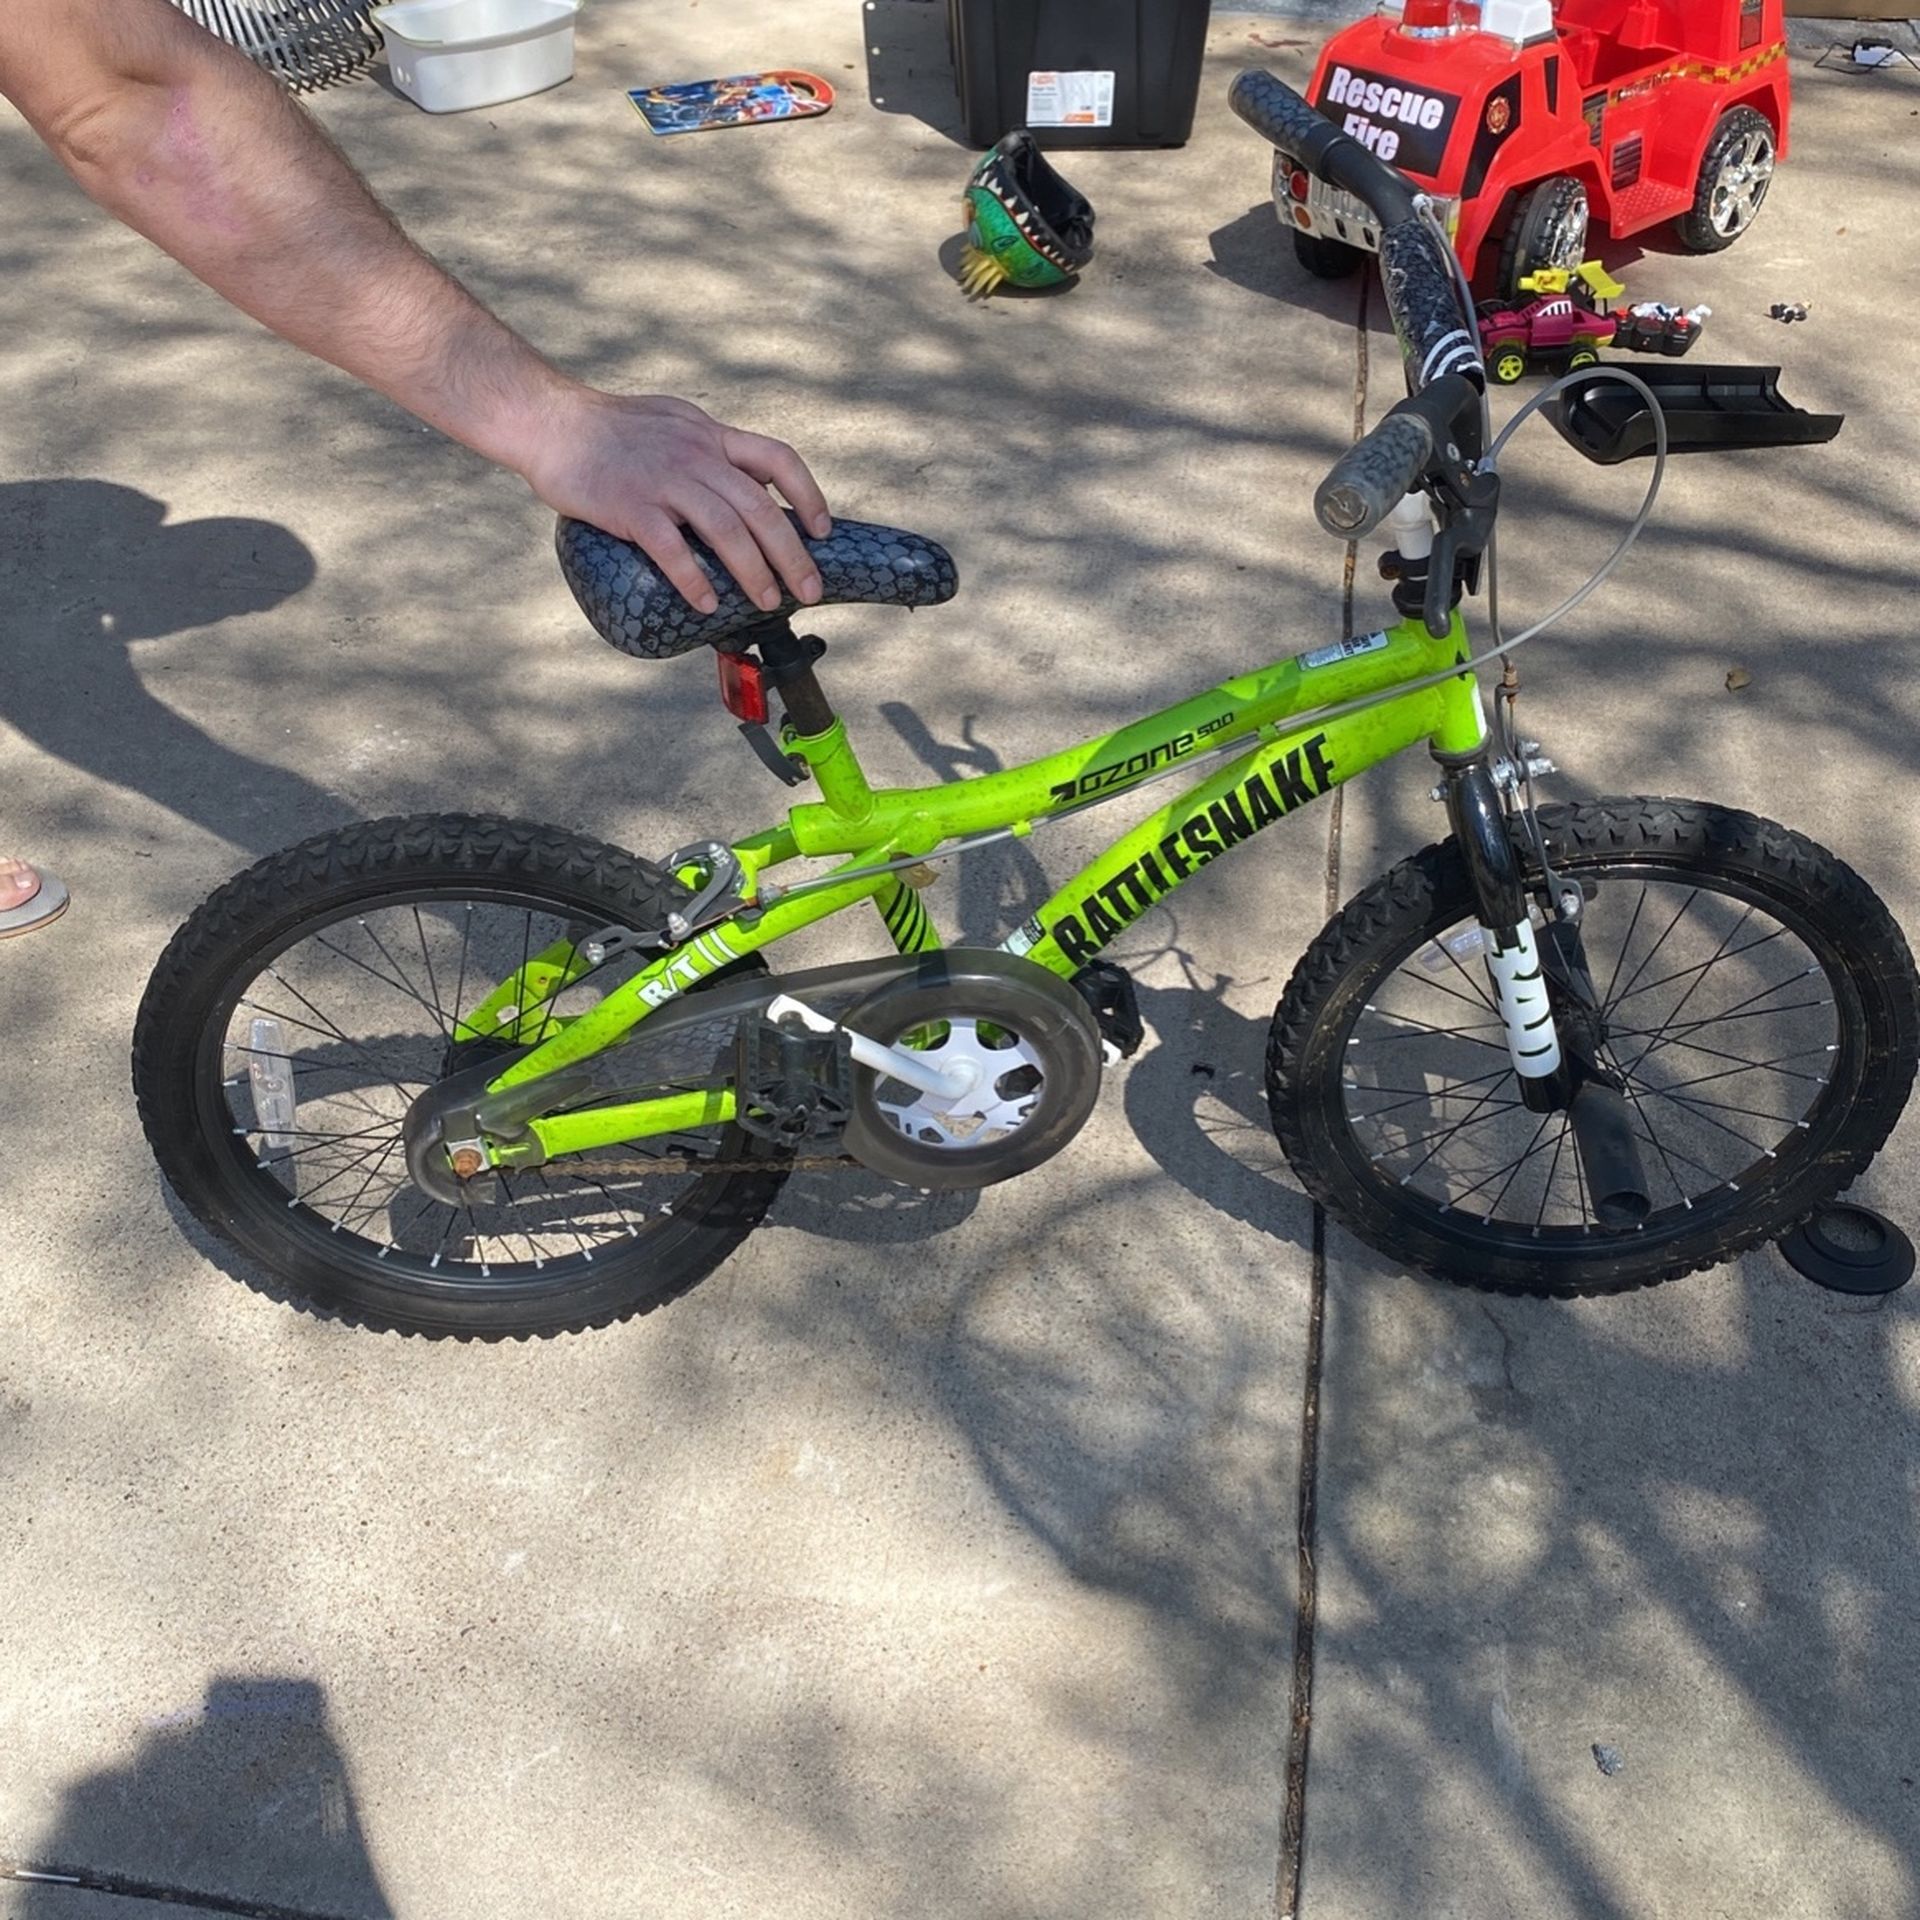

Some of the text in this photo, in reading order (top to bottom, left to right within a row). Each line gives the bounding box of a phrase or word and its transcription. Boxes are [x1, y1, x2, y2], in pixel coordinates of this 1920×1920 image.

[1327, 66, 1445, 130] Rescue
[1342, 112, 1400, 161] Fire
[1196, 711, 1235, 740] 500
